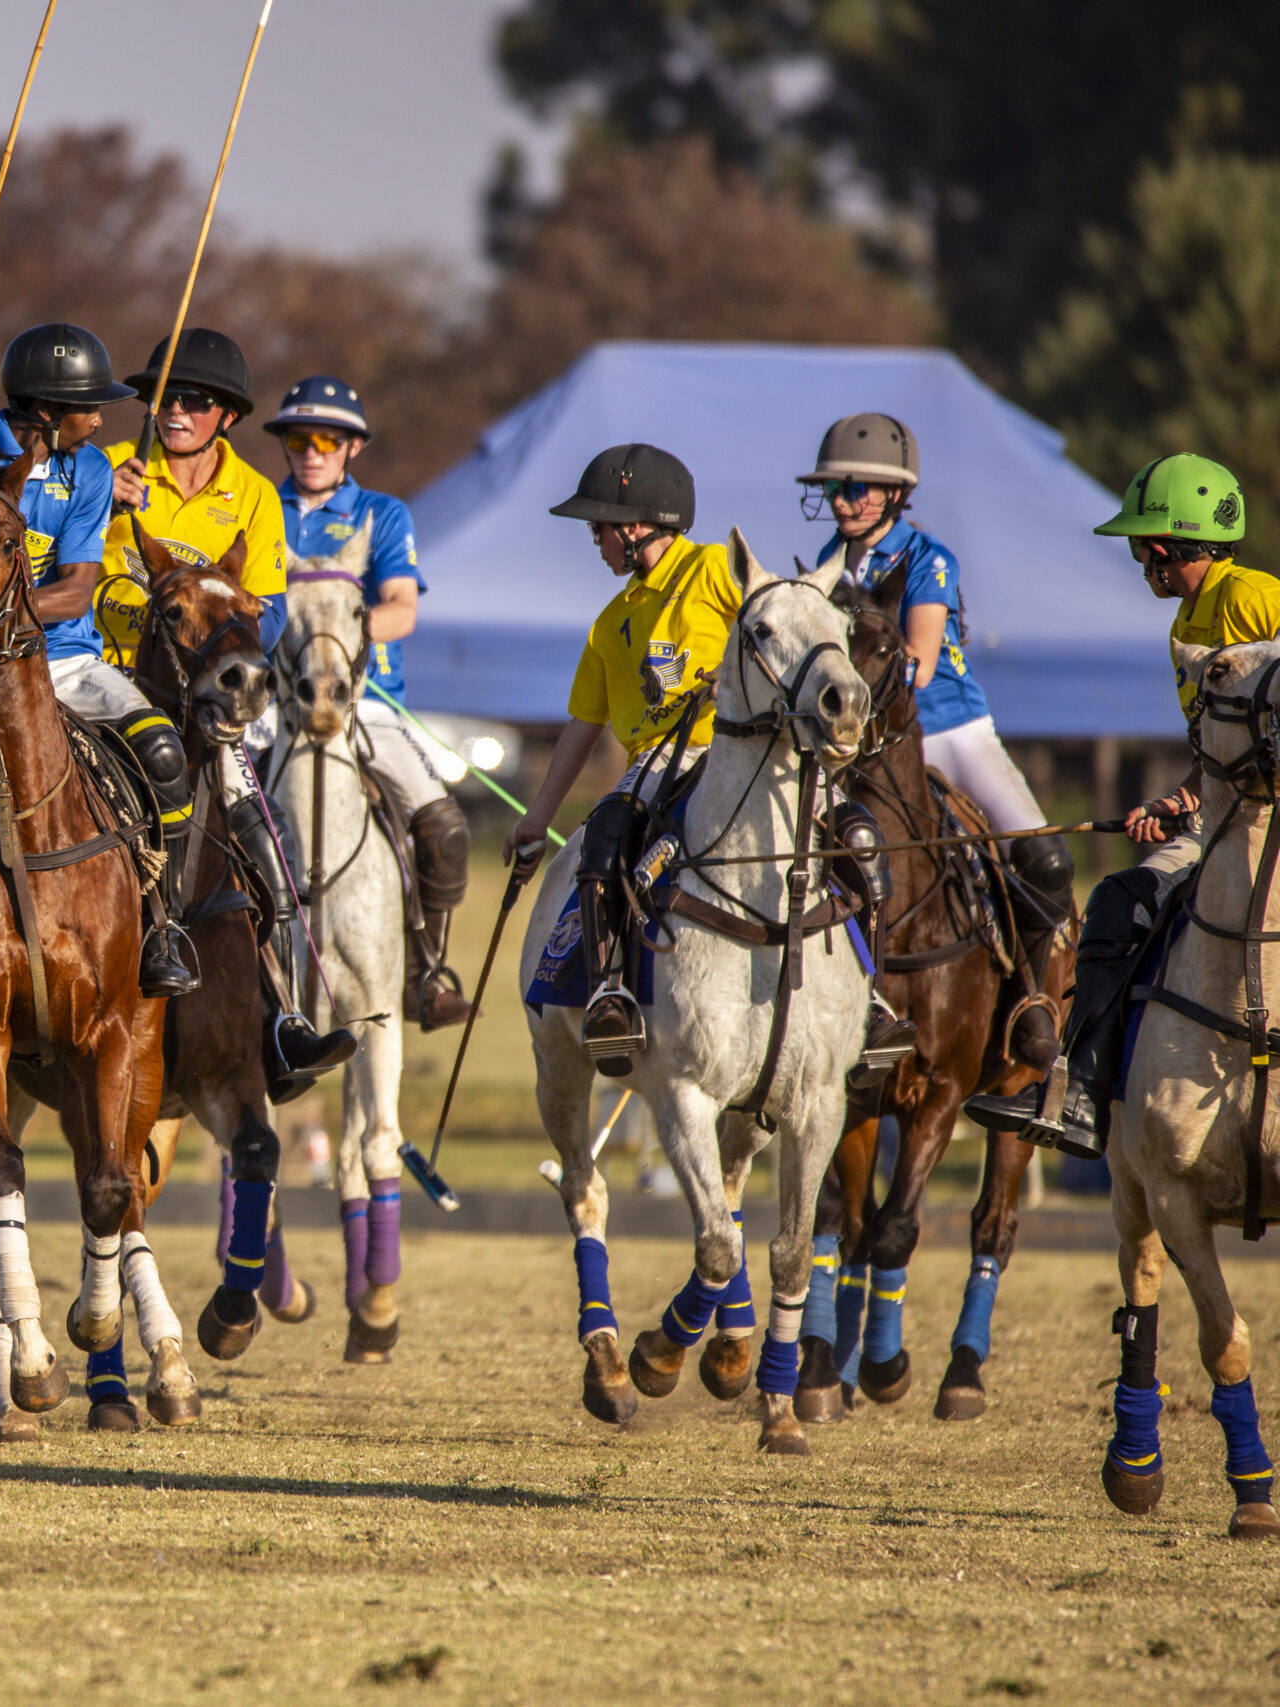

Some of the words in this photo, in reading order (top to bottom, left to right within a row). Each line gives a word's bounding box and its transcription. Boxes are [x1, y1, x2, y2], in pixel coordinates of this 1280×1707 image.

[168, 545, 199, 564] KLESS
[935, 571, 946, 588] 1
[104, 597, 145, 621] RECKL
[619, 616, 632, 648] 1
